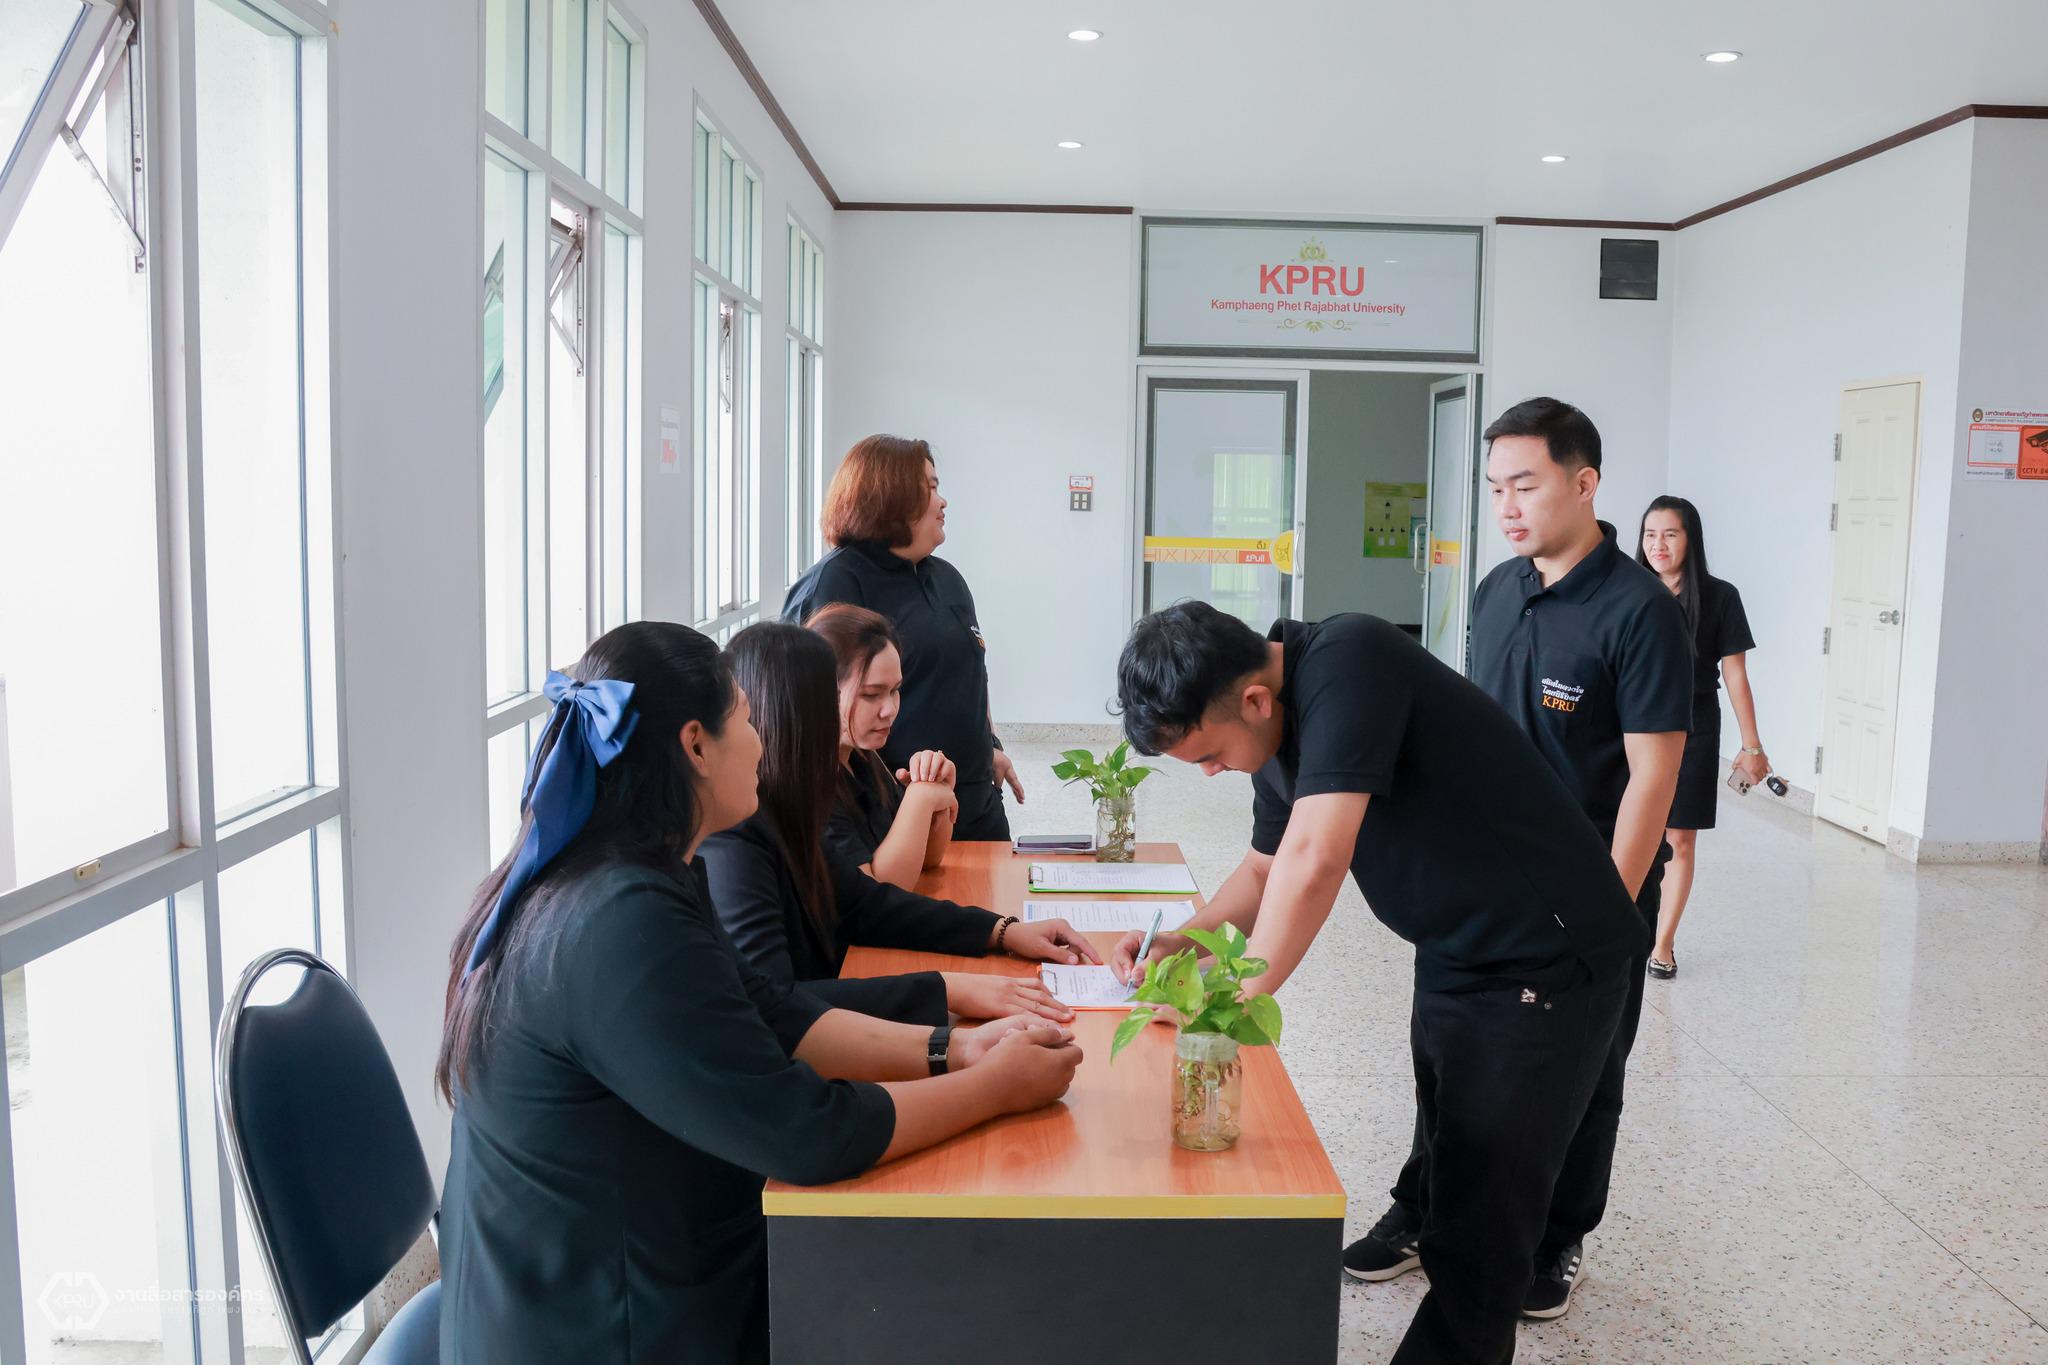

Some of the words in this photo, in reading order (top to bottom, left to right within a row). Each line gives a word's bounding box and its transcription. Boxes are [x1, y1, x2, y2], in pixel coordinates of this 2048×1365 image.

[1259, 264, 1366, 296] KPRU
[1211, 299, 1274, 313] Kamphaeng
[1277, 301, 1302, 311] Phet
[1304, 301, 1351, 314] Rajabhat
[1353, 302, 1406, 316] University
[1542, 695, 1576, 712] KPRU
